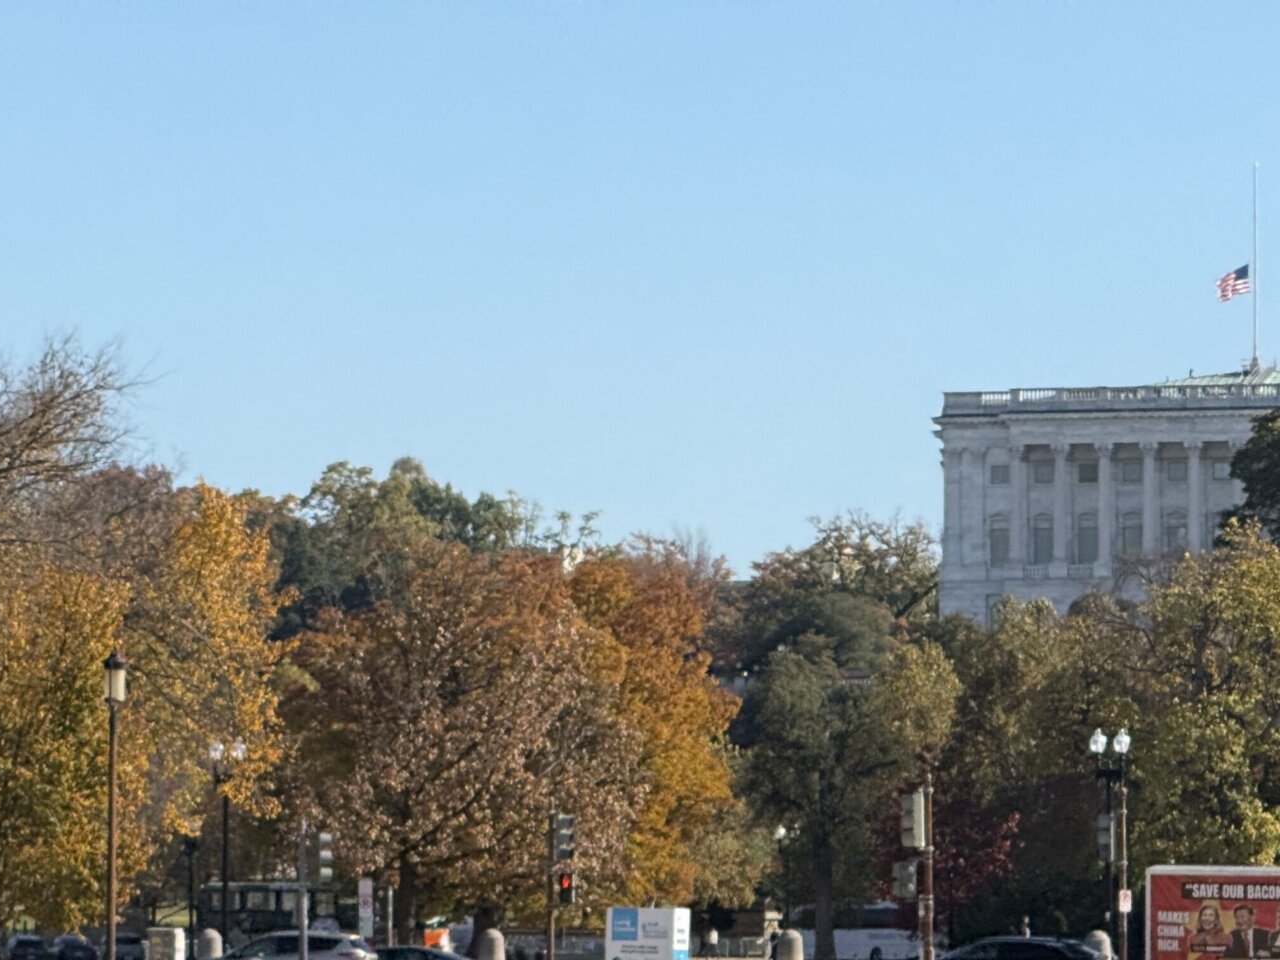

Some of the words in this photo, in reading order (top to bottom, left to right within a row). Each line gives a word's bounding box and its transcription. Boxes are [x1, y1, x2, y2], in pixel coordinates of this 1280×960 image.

[1222, 884, 1244, 899] OUR
[1157, 911, 1190, 923] MAKES
[1157, 925, 1185, 937] CHINA
